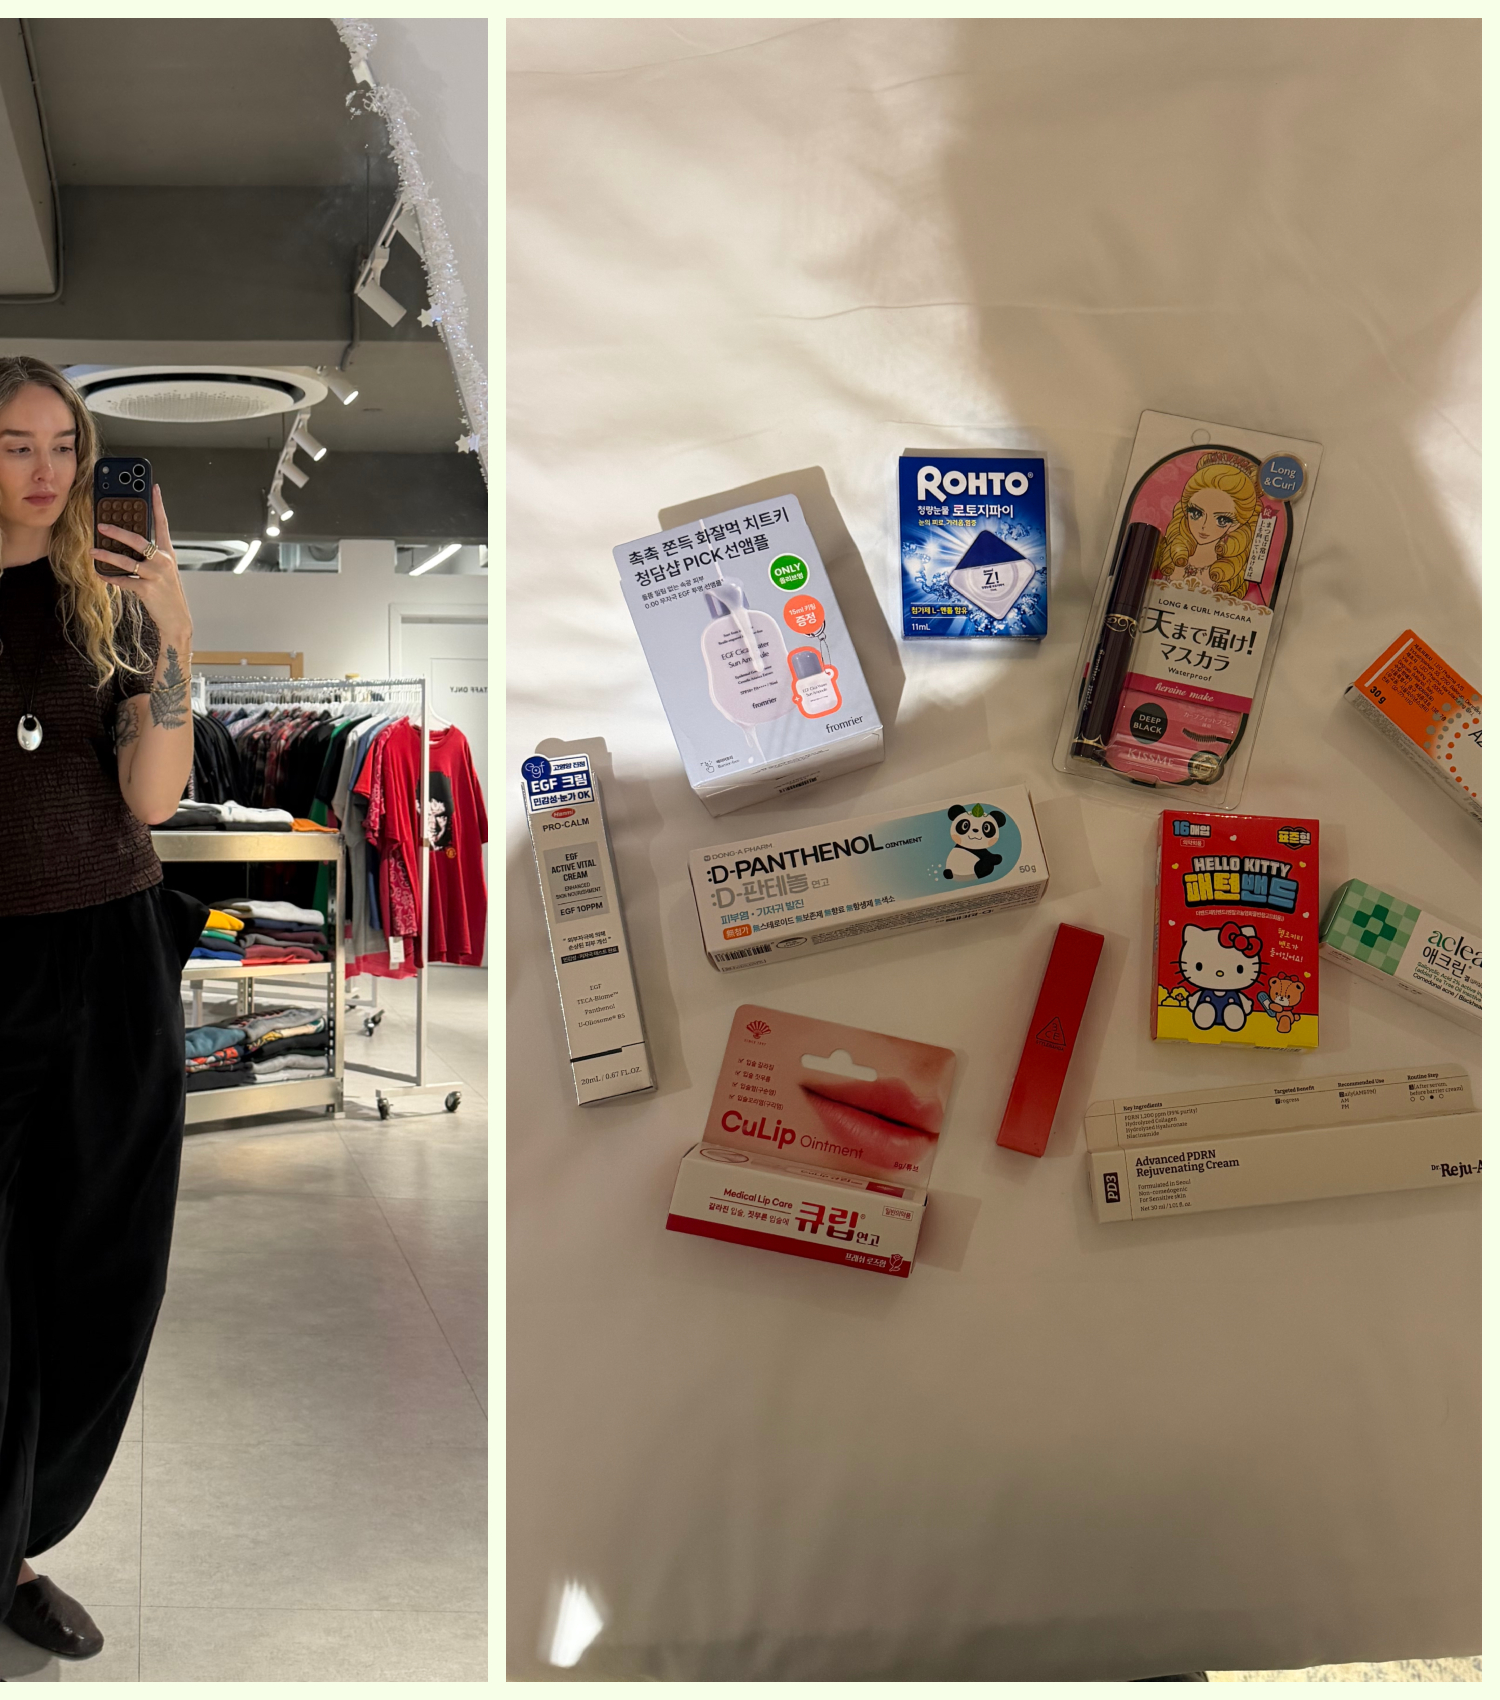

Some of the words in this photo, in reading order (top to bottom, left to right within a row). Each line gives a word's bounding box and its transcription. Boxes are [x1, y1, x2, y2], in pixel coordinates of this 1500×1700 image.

[1270, 461, 1296, 479] Long
[917, 465, 1030, 503] ROHTO
[917, 505, 949, 517] 청량눈물
[952, 504, 1014, 518] 로토지파이
[628, 546, 660, 566] 촉촉
[662, 534, 694, 557] 쫀득
[694, 518, 742, 545] 화잘먹
[743, 506, 790, 531] 치트키
[634, 559, 682, 588] 청담샵
[683, 547, 724, 571] PICK
[725, 534, 770, 559] 선앰플
[774, 563, 801, 577] ONLY
[983, 571, 1000, 585] Z!
[1158, 598, 1181, 609] LONG
[1190, 605, 1211, 615] CURL
[1213, 609, 1252, 624] MASCARA
[795, 612, 817, 627] 증정
[911, 623, 931, 631] 11mL
[1142, 607, 1257, 655] 天まで届け!
[1160, 642, 1230, 672] マスカラ
[1168, 666, 1213, 682] Waterproof
[1154, 682, 1187, 696] heroine
[1189, 690, 1214, 702] make
[1369, 685, 1382, 698] 30
[1378, 695, 1387, 705] g
[752, 697, 777, 709] fromrier
[825, 715, 863, 734] fromrier
[1139, 713, 1162, 725] DEEP
[1133, 721, 1162, 735] BLACK
[531, 777, 558, 793] EGF
[561, 773, 588, 788] 크림
[577, 790, 591, 800] OK
[542, 817, 590, 832] PRO-CALM
[1173, 820, 1211, 838] 16매입
[885, 835, 923, 849] OINTMENT
[1278, 829, 1311, 845] 표준형
[565, 852, 579, 862] EGF
[711, 849, 743, 860] DONG-A
[551, 862, 576, 874] ACTIVE
[576, 858, 597, 870] VITAL
[1193, 857, 1240, 872] HELLO
[1244, 857, 1292, 877] KITTY
[563, 870, 588, 882] CREAM
[811, 878, 831, 889] 연고
[564, 882, 591, 892] ENHANCED
[1184, 872, 1298, 910] 패턴밴드
[560, 907, 576, 916] EGF
[576, 901, 604, 913] 10PPM
[720, 910, 750, 925] 피부염
[755, 901, 785, 917] 기저귀
[785, 898, 805, 912] 발진
[1278, 927, 1304, 941] 헬로키티
[1422, 946, 1467, 979] 애크린
[589, 983, 602, 991] EGF
[584, 1003, 616, 1015] Panthenol
[1133, 1102, 1163, 1111] Ingredients
[721, 1109, 797, 1150] CuLip
[800, 1134, 864, 1160] Ointment
[1135, 1151, 1185, 1167] Advanced
[1186, 1149, 1216, 1161] PDRN
[1136, 1162, 1205, 1179] Rejuvenating
[1205, 1158, 1240, 1170] Cream
[1106, 1175, 1119, 1200] PD3
[723, 1188, 757, 1203] Medical
[757, 1195, 771, 1207] Lip
[771, 1198, 793, 1209] Care
[708, 1201, 729, 1214] 갈라진
[769, 1214, 790, 1226] 입술에
[795, 1200, 859, 1242] 큐립
[856, 1231, 881, 1248] 연고
[844, 1252, 866, 1264] 프레쉬
[866, 1256, 887, 1268] 로즈향
